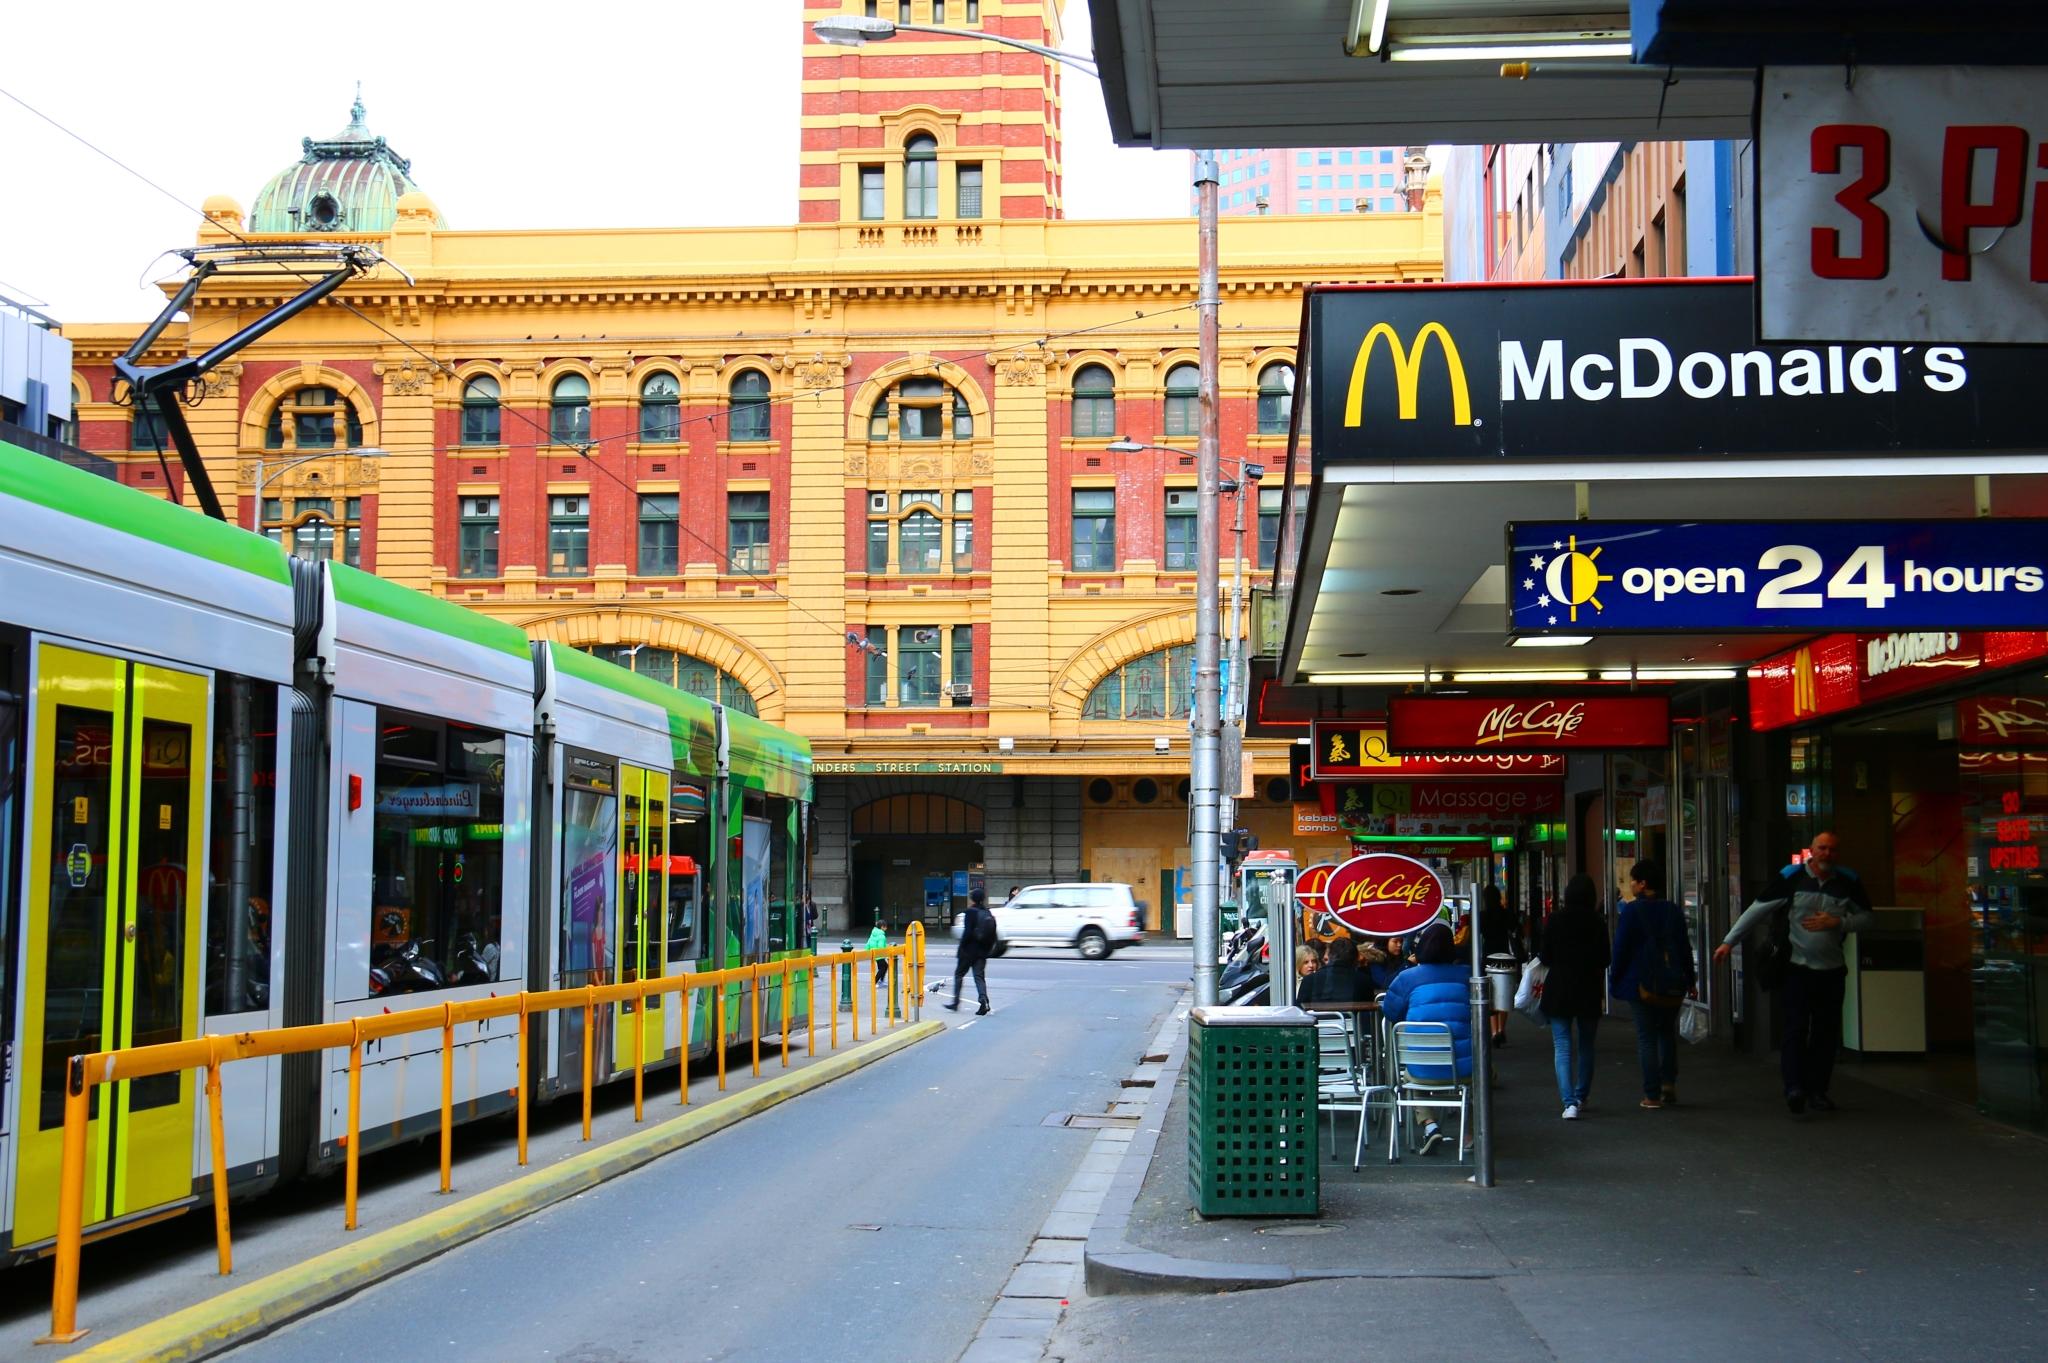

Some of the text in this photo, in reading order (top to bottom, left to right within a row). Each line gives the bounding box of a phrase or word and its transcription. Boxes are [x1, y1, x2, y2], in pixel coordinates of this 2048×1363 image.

[1810, 124, 1891, 281] 3
[1621, 544, 2044, 609] open 24 hours
[1867, 632, 1960, 677] McDonalds
[1477, 701, 1586, 744] McCafé
[1364, 736, 1386, 763] Q
[875, 763, 920, 773] STREET
[937, 763, 992, 773] STATION
[1417, 787, 1528, 812] Massage
[1297, 813, 1338, 822] kebab
[1297, 824, 1338, 832] combo
[1338, 873, 1432, 911] McCafé
